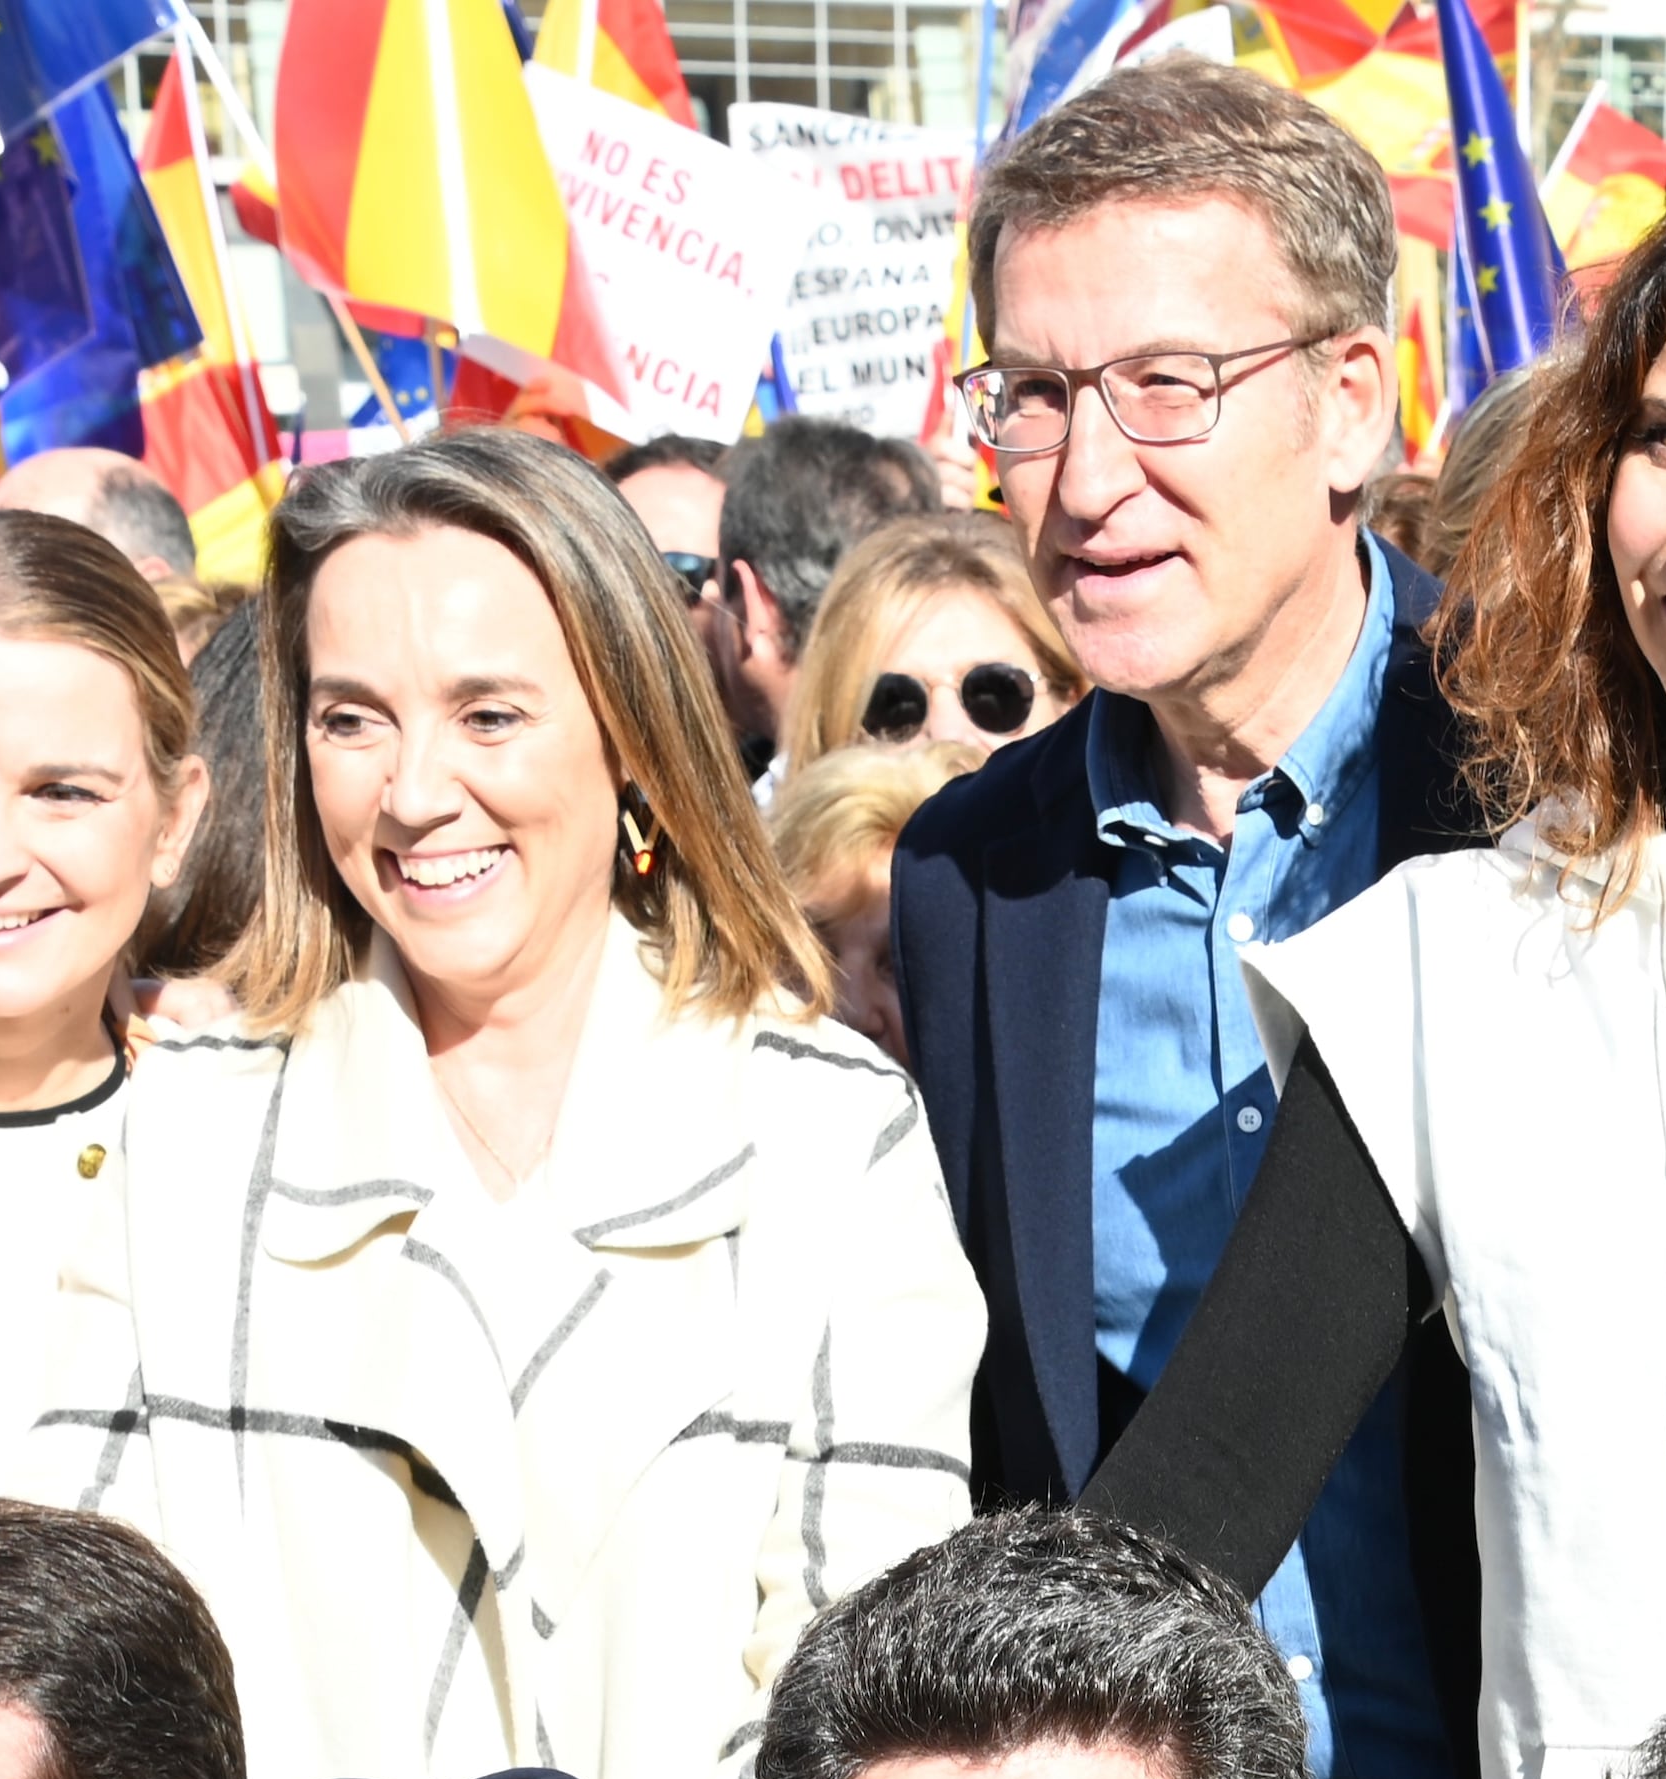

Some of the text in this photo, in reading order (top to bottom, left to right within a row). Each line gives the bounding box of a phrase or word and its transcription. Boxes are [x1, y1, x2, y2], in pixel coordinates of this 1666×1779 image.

[579, 128, 692, 206] NO ES
[810, 303, 945, 346] EUROPA
[797, 365, 839, 395] EL
